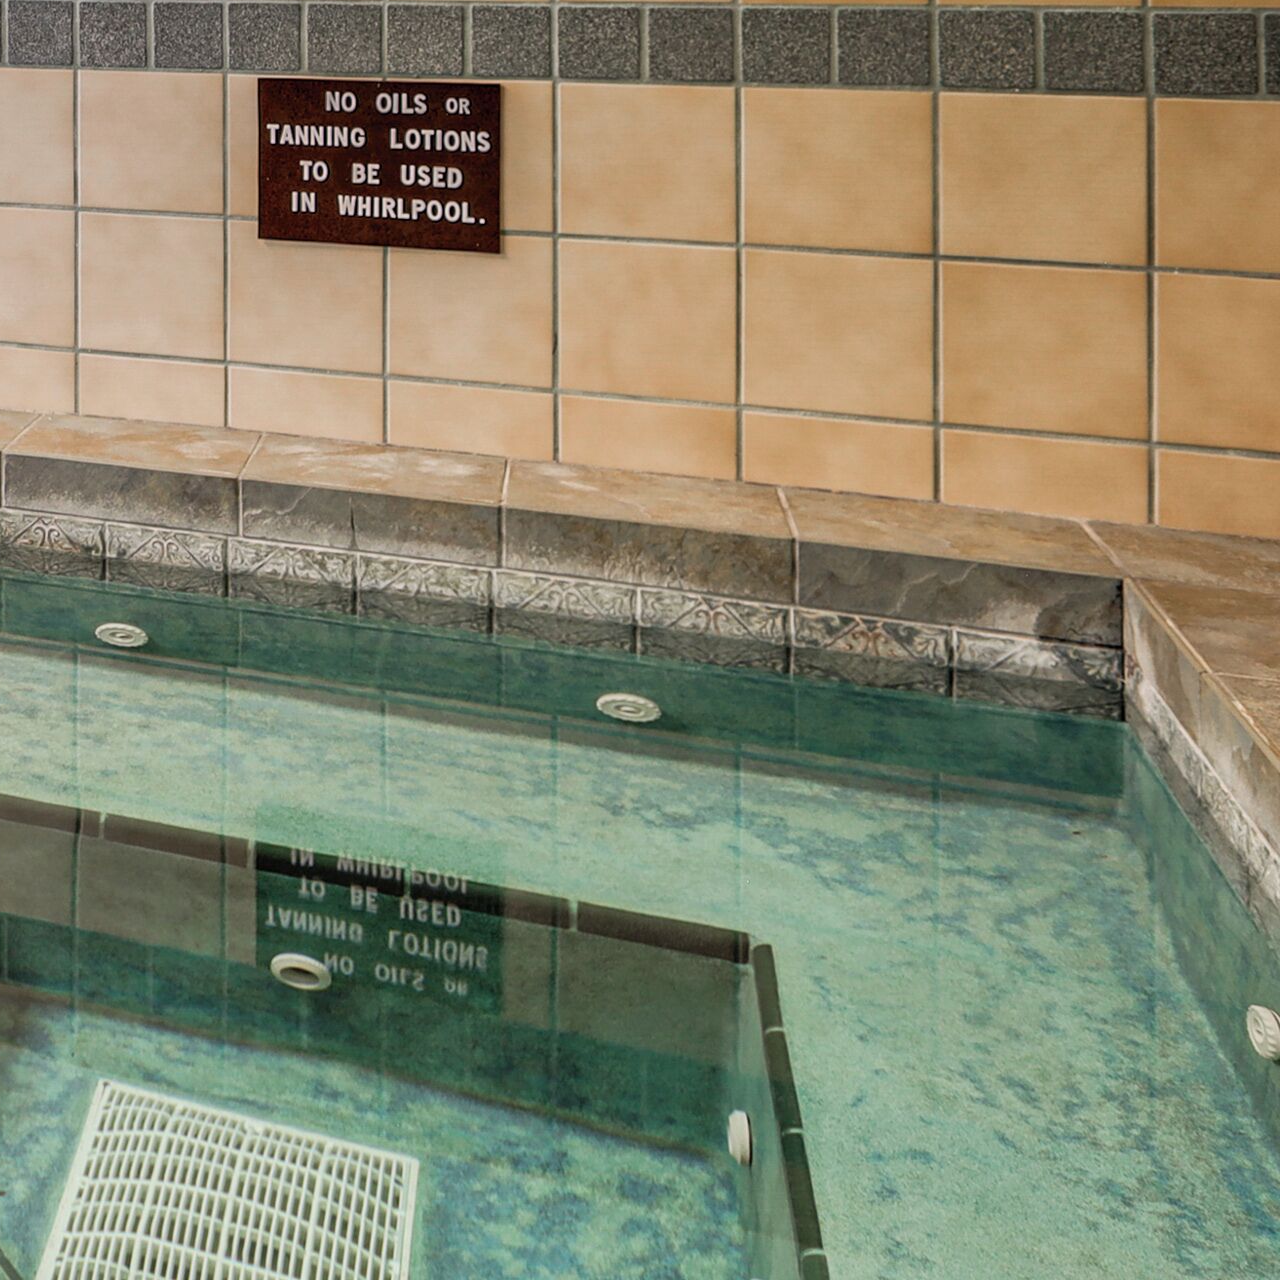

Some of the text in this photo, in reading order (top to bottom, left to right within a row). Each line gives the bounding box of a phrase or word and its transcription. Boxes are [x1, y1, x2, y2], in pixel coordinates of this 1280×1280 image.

[324, 90, 471, 116] NO OILS OR
[266, 123, 491, 153] TANNING LOTIONS
[299, 159, 463, 189] TO BE USED
[291, 190, 486, 225] IN WHIRLPOOL.
